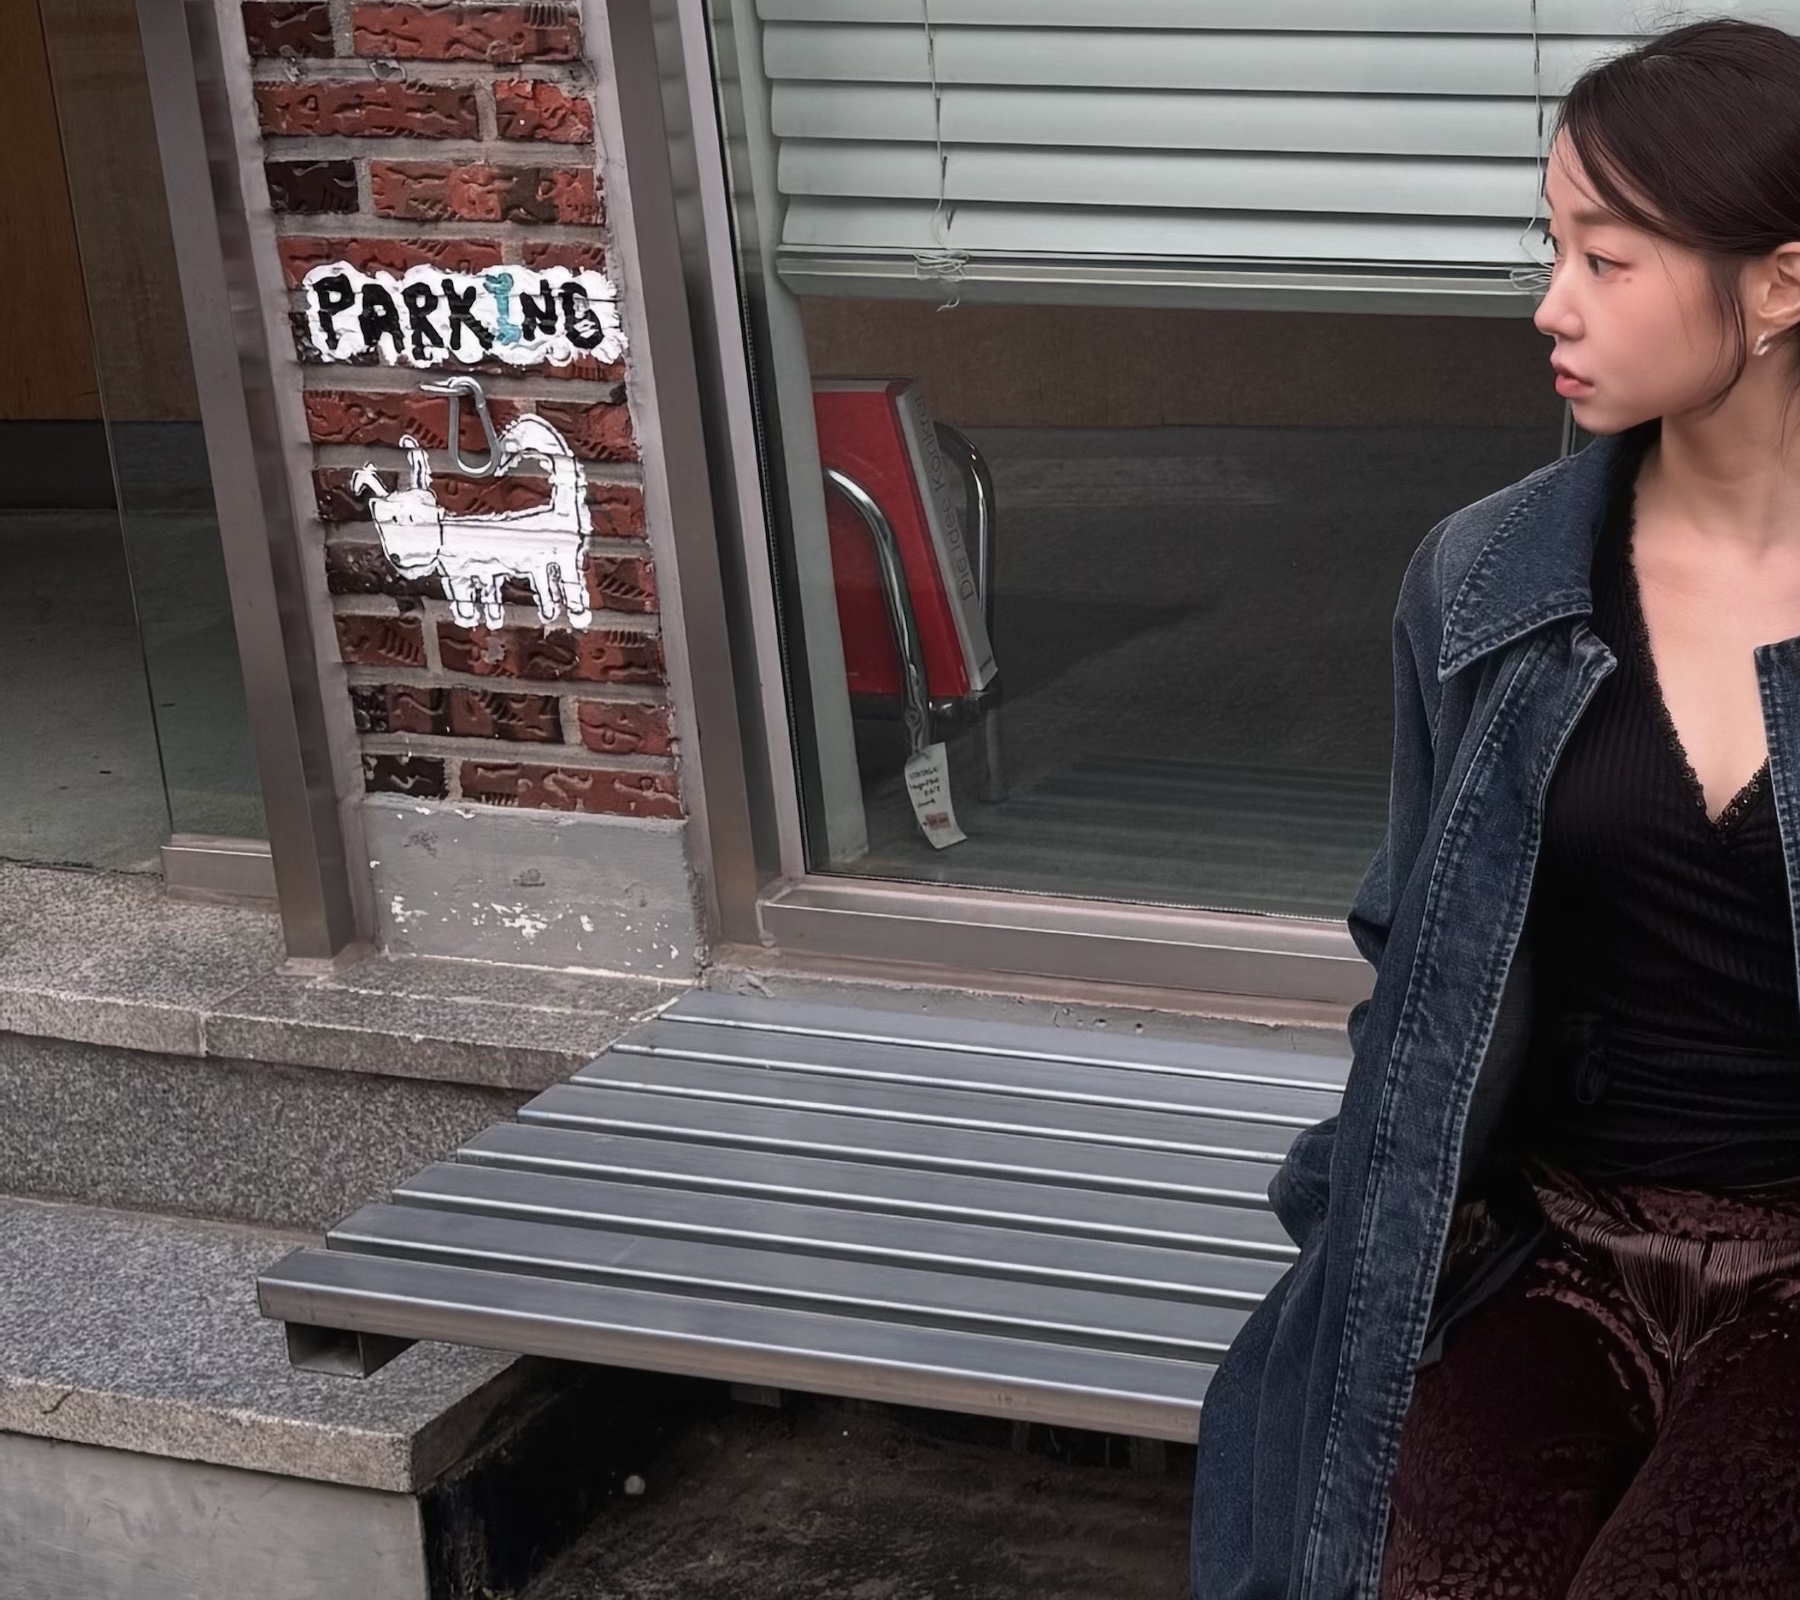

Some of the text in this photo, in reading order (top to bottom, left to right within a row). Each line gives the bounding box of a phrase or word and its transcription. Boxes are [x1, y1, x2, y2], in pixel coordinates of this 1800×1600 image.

[311, 271, 605, 361] PARKING
[937, 497, 961, 552] Idee
[956, 556, 976, 602] Die
